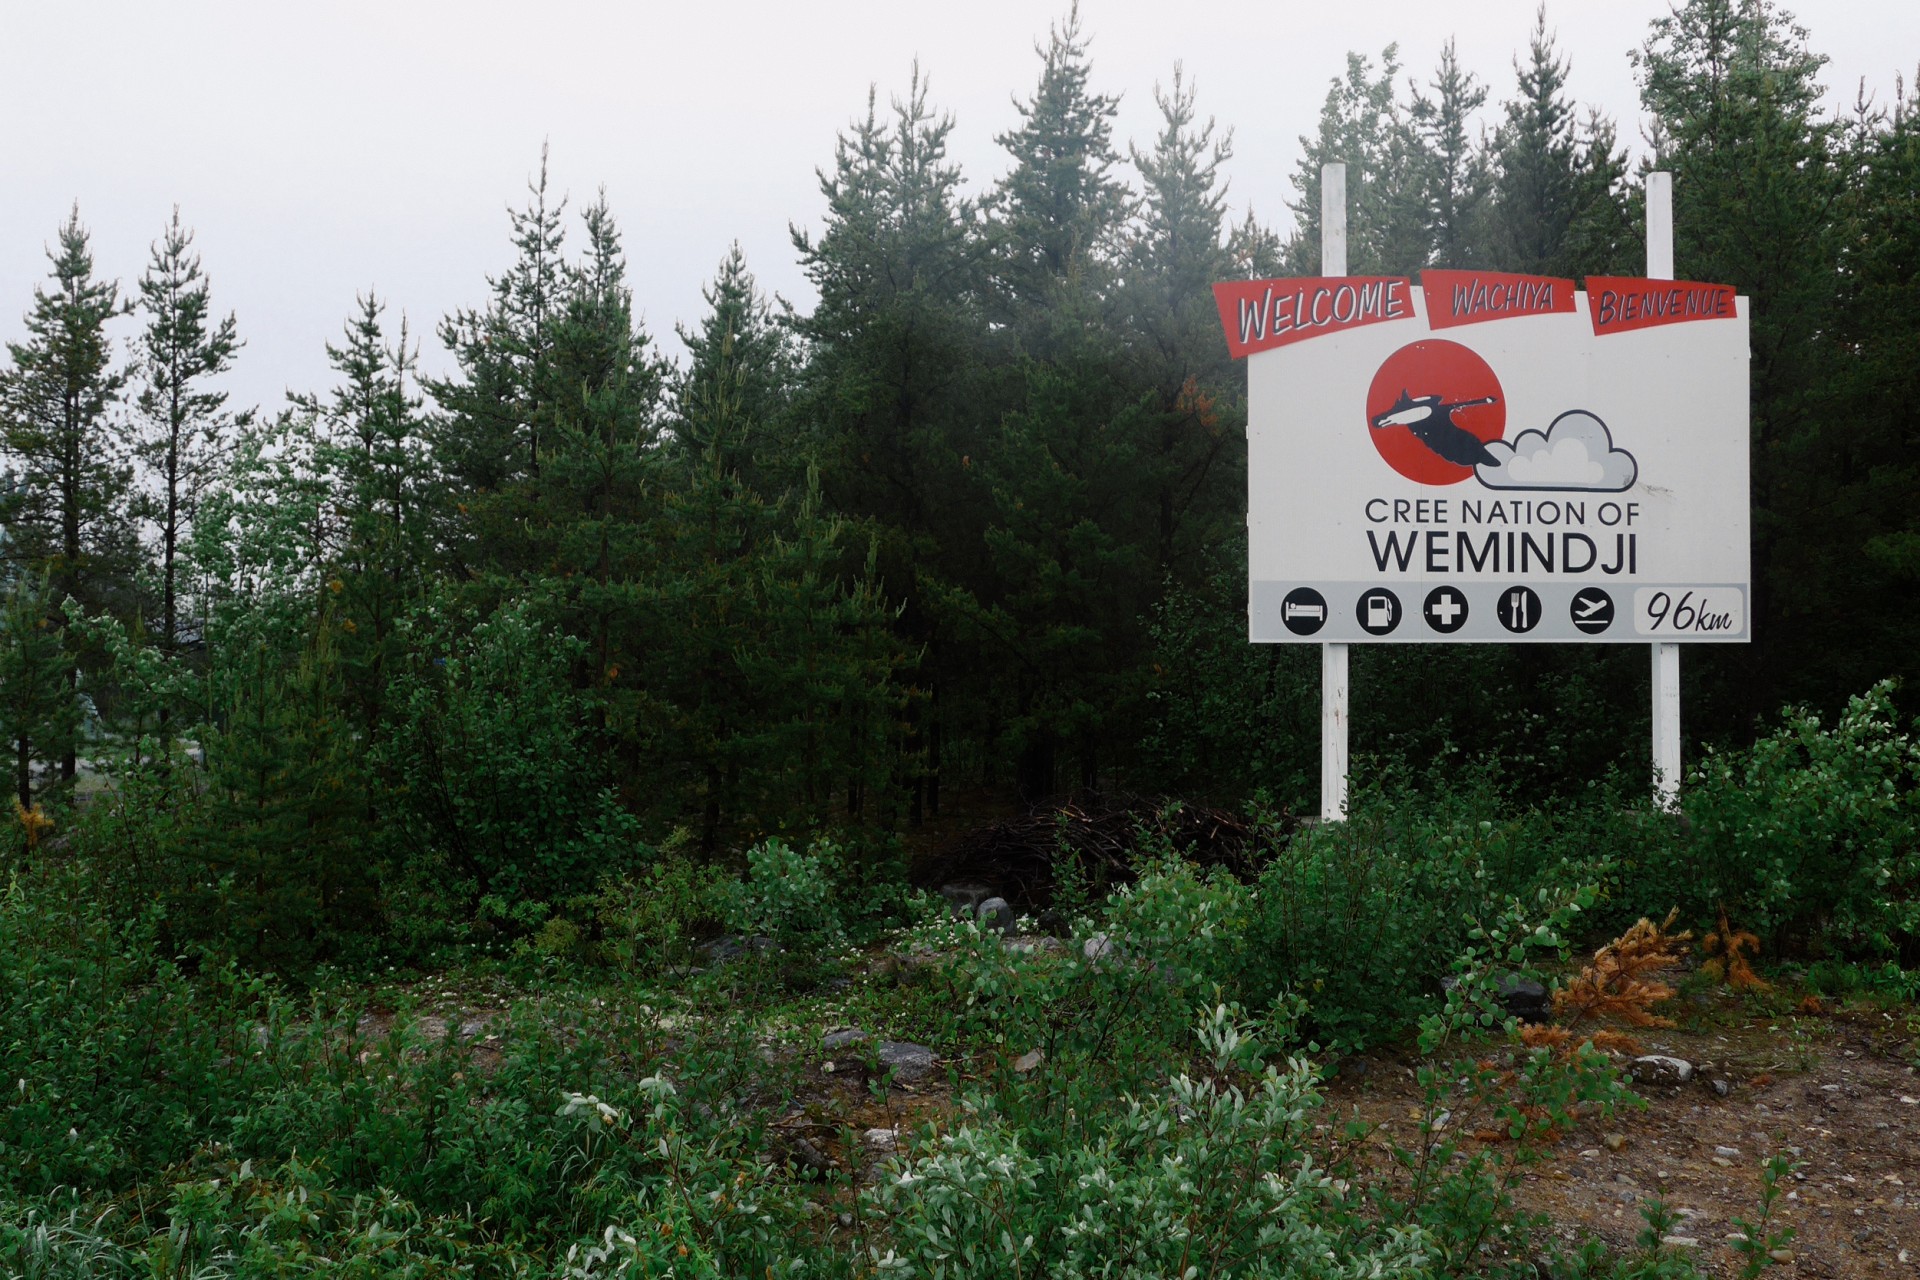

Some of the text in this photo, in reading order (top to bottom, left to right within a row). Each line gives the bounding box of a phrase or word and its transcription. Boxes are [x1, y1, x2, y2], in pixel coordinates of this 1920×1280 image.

[1238, 281, 1405, 344] WELCOME
[1452, 278, 1554, 317] WACHIYA
[1600, 289, 1729, 326] BIENVENUE
[1365, 498, 1639, 526] CREE NATION OF
[1366, 530, 1637, 575] WEMINDJI
